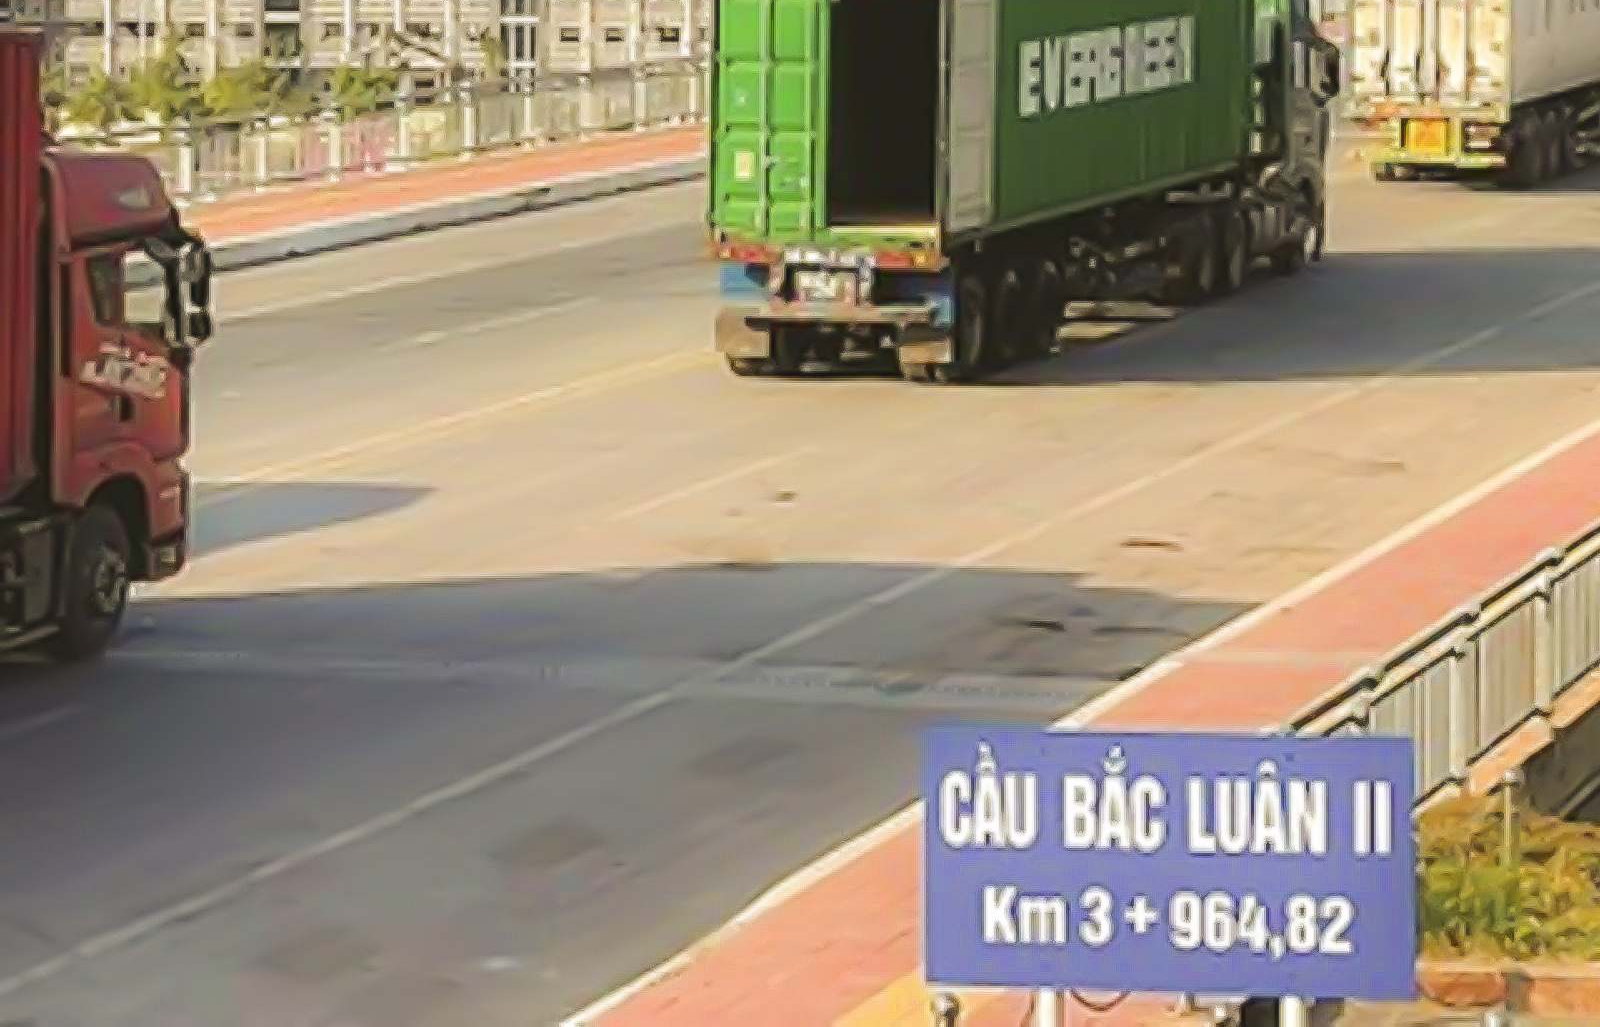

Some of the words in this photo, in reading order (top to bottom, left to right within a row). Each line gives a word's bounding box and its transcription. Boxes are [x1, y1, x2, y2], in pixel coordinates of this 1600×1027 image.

[938, 740, 1040, 851] CẦU
[1062, 745, 1168, 856] BẮC
[1187, 759, 1330, 859] LUÂN
[1352, 779, 1395, 859] II
[982, 884, 1068, 947] Km
